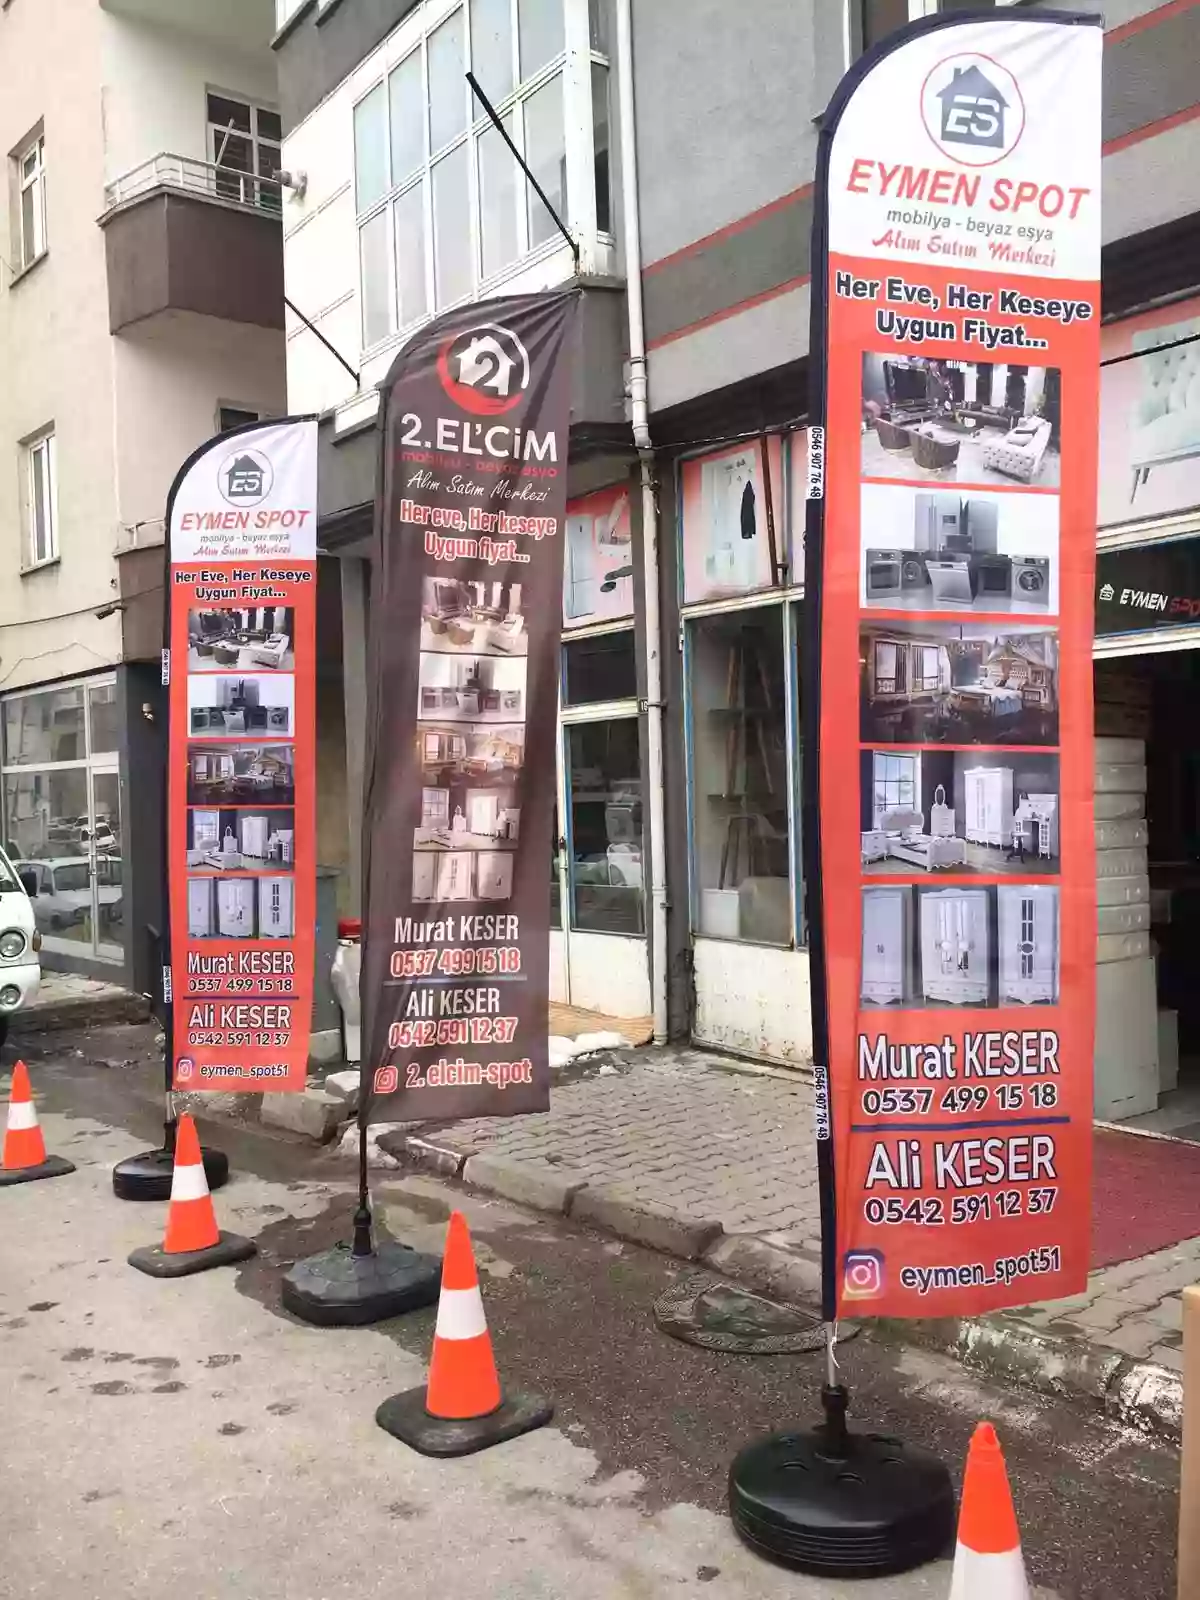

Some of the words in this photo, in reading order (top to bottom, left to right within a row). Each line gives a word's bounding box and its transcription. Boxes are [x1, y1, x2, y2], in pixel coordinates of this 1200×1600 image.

[945, 95, 999, 137] ES
[846, 158, 981, 207] EYMEN
[989, 178, 1090, 219] SPOT
[886, 209, 951, 230] mobilya
[966, 216, 1012, 237] beyaz
[1017, 225, 1054, 243] eşya
[872, 229, 921, 250] Alım
[988, 241, 1056, 267] Merkezi
[836, 271, 879, 298] Her
[887, 278, 940, 310] Eve,
[947, 285, 993, 312] Her
[999, 289, 1092, 323] Keseye
[876, 310, 955, 342] Uygun
[963, 319, 1048, 350] Fiyat...
[811, 427, 823, 450] 0546
[811, 453, 822, 470] 907
[445, 474, 485, 497] Satım
[490, 479, 551, 502] Merkezi
[810, 472, 821, 484] 76
[810, 486, 821, 498] 48
[180, 511, 250, 531] EYMEN
[254, 510, 311, 529] SPOT
[400, 499, 430, 523] Her
[430, 505, 467, 531] eve,
[470, 508, 498, 532] Her
[497, 510, 557, 540] keseye
[424, 531, 478, 561] Uygun
[479, 537, 531, 565] fiyat...
[175, 571, 197, 583] Her
[200, 569, 228, 583] Eve,
[233, 568, 257, 581] Her
[260, 567, 312, 585] Keseye
[196, 586, 237, 601] Uygun
[241, 586, 287, 599] Fiyat...
[1120, 588, 1169, 612] EYMEN
[394, 916, 455, 943] Murat
[460, 915, 519, 941] KESER
[188, 951, 237, 974] Murat
[239, 951, 295, 974] KESER
[390, 949, 437, 978] 0537
[437, 947, 476, 975] 499
[476, 947, 498, 973] 15
[498, 946, 521, 973] 18
[189, 978, 222, 992] 0537
[226, 978, 253, 992] 499
[257, 978, 273, 992] 15
[276, 978, 293, 992] 18
[406, 989, 434, 1017] Ali
[439, 988, 500, 1016] KESER
[188, 1005, 214, 1029] Ali
[220, 1005, 291, 1029] KESER
[189, 1033, 223, 1046] 0542
[227, 1033, 251, 1046] 591
[255, 1033, 271, 1046] 12
[274, 1033, 290, 1046] 37
[389, 1020, 436, 1049] 0542
[437, 1017, 469, 1045] 591
[469, 1017, 493, 1044] 12
[493, 1016, 518, 1043] 37
[858, 1033, 956, 1080] Murat
[963, 1030, 1060, 1078] KESER
[200, 1064, 289, 1079] eymen_spot51
[815, 1067, 826, 1090] 0546
[816, 1092, 827, 1110] 907
[862, 1088, 933, 1115] 0537
[942, 1085, 988, 1112] 499
[995, 1084, 1023, 1110] 15
[1029, 1082, 1057, 1108] 18
[816, 1112, 828, 1124] 76
[817, 1127, 828, 1138] 48
[864, 1140, 922, 1189] Ali
[935, 1135, 1057, 1189] KESER
[864, 1198, 944, 1225] 0542
[952, 1194, 990, 1224] 591
[995, 1191, 1021, 1217] 12
[1028, 1188, 1057, 1214] 37
[900, 1246, 1061, 1295] eymen_spot51
